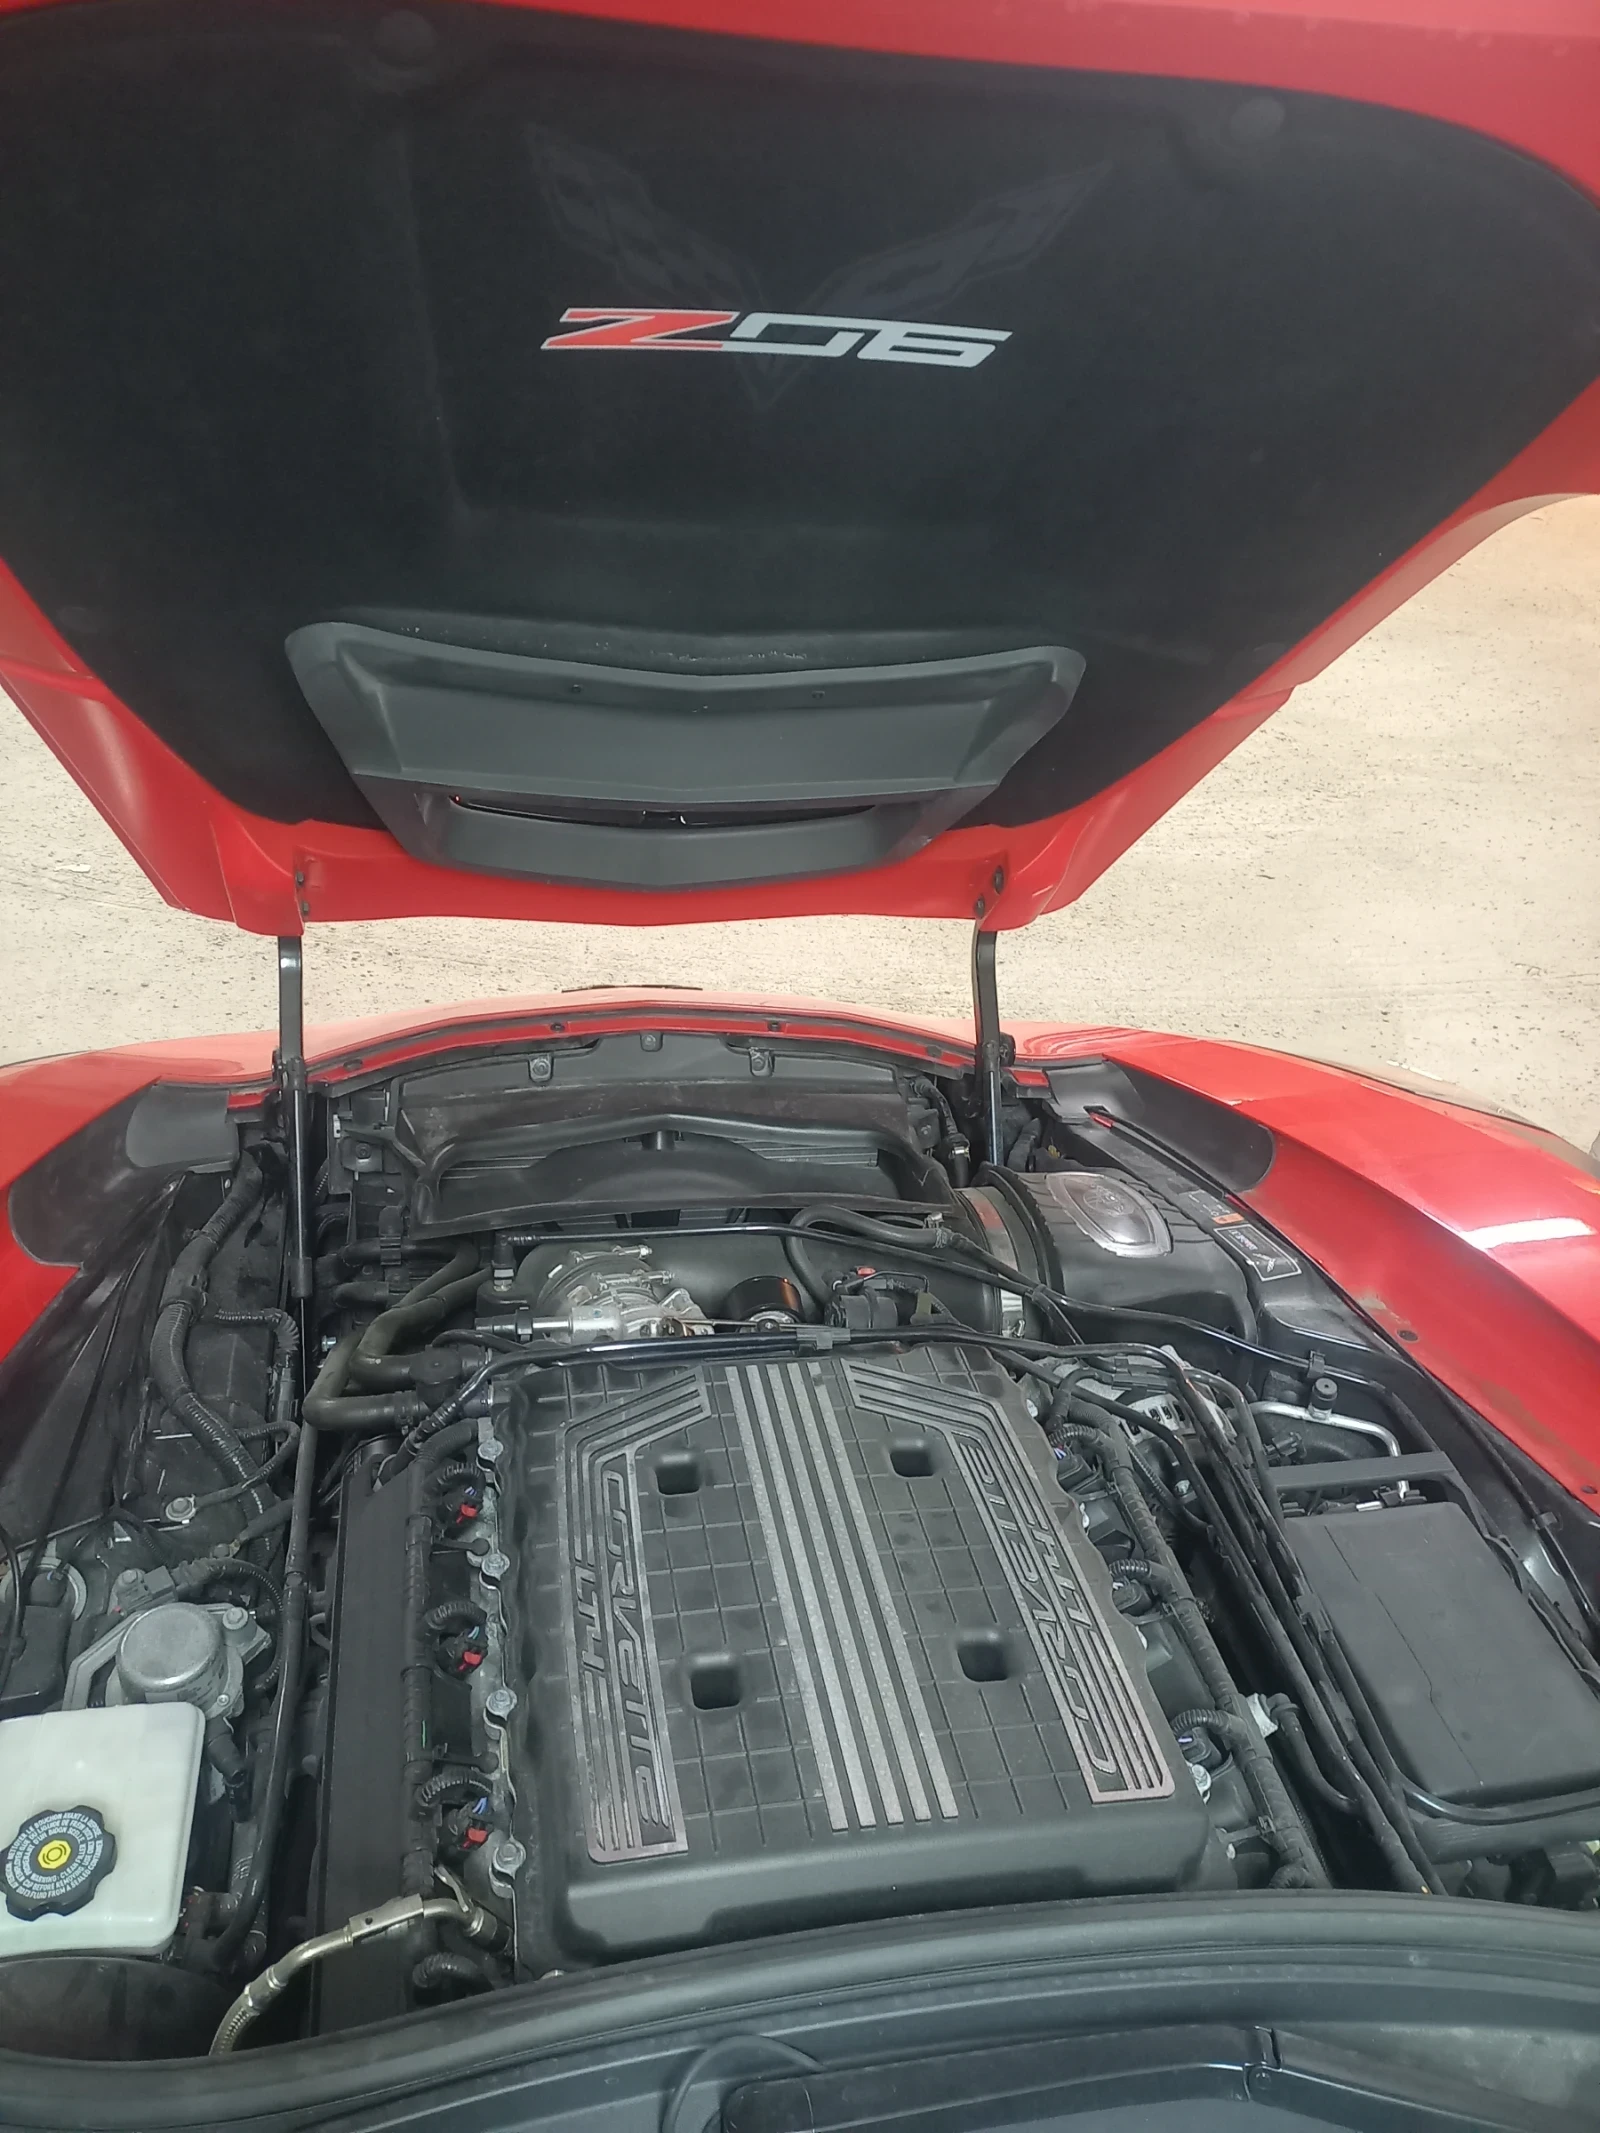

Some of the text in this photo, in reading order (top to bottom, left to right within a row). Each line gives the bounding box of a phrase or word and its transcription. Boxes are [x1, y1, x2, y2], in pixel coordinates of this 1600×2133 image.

[541, 308, 1012, 367] Z06
[574, 1564, 608, 1675] LT4
[960, 1443, 1117, 1774] CORVETTE
[1030, 1526, 1096, 1635] LT4
[603, 1469, 670, 1828] CORVETTE
[79, 1815, 89, 1823] LA
[28, 1891, 47, 1899] FLUID
[47, 1887, 66, 1899] FROM
[70, 1870, 92, 1889] SEALED
[60, 1862, 80, 1880] CLEAN
